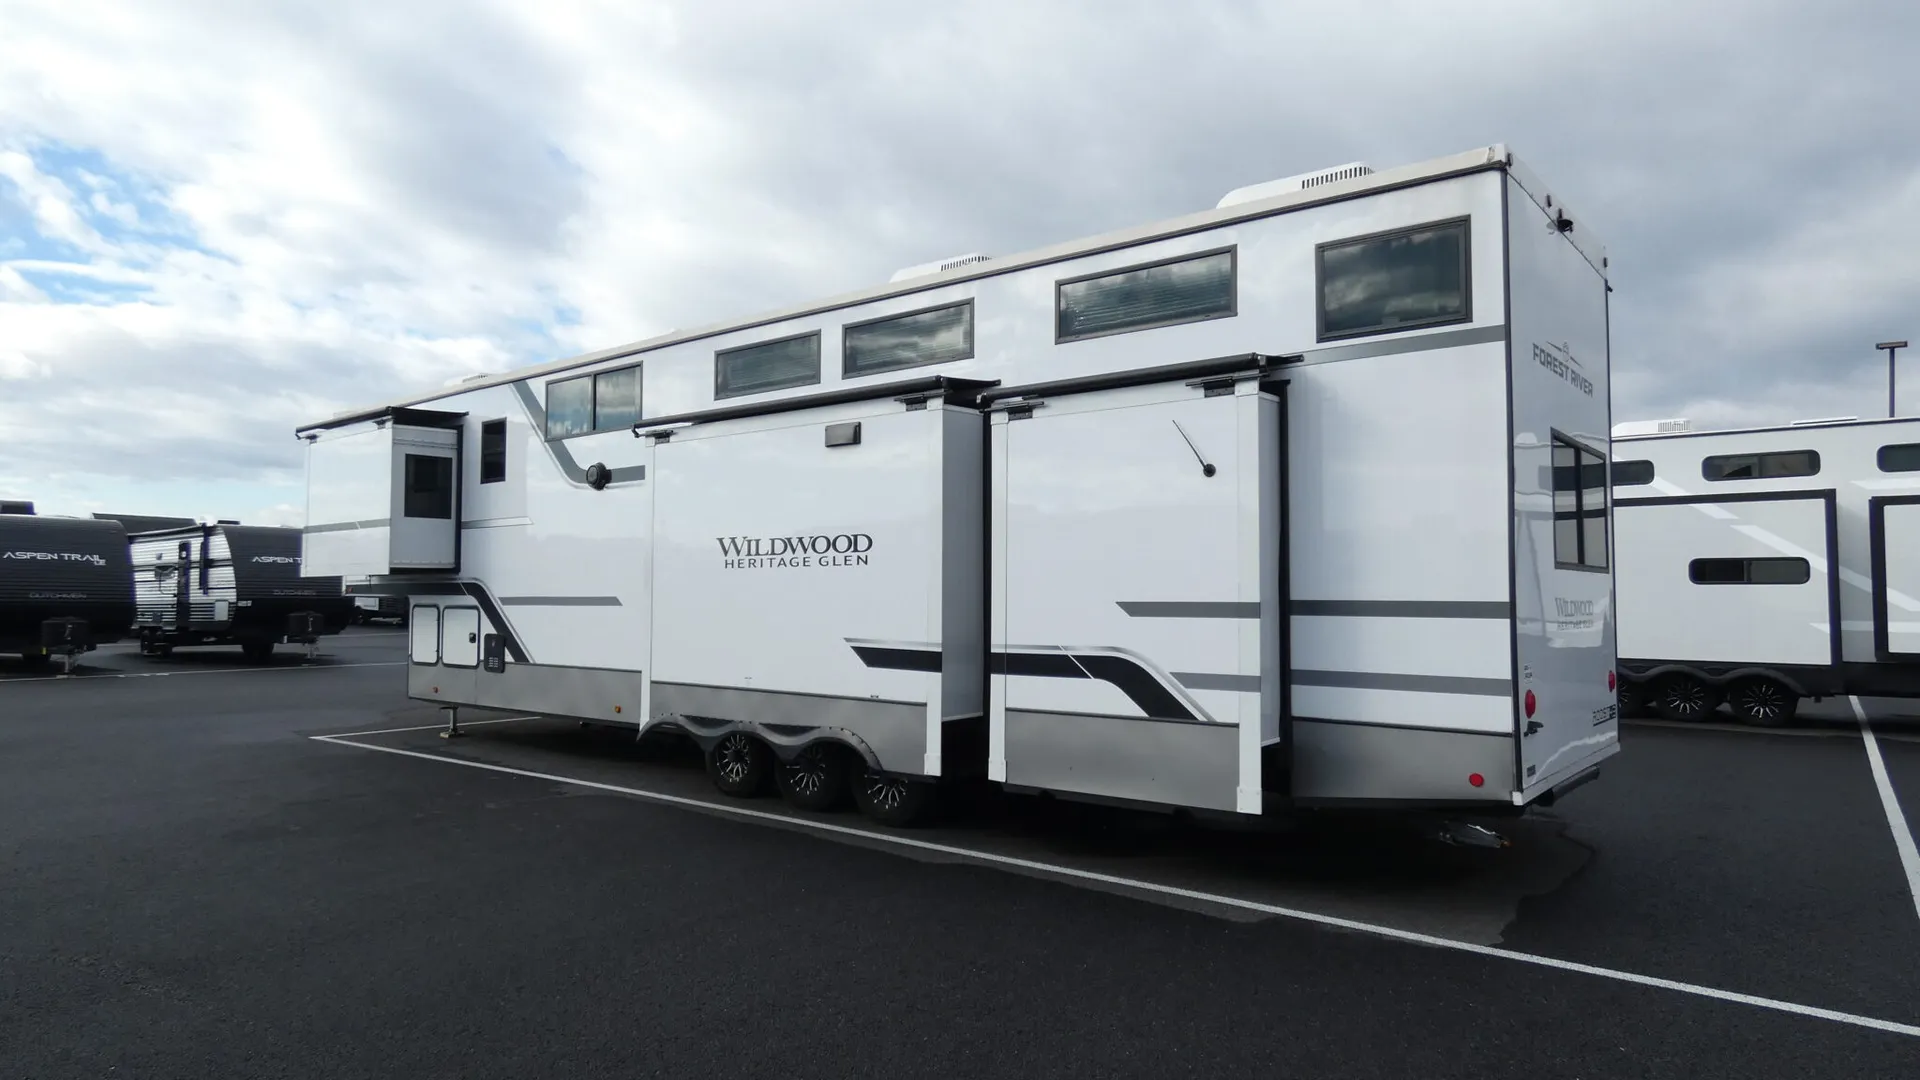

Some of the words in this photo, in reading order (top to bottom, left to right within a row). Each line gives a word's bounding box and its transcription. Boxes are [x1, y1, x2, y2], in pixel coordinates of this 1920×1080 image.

[1532, 342, 1570, 381] FOREST
[1570, 368, 1593, 398] RIVER
[716, 534, 873, 557] WILDWOOD
[3, 551, 58, 560] ASPEN
[60, 553, 101, 562] TRAIL
[724, 556, 811, 569] HERITAGE
[818, 554, 868, 567] GLEN
